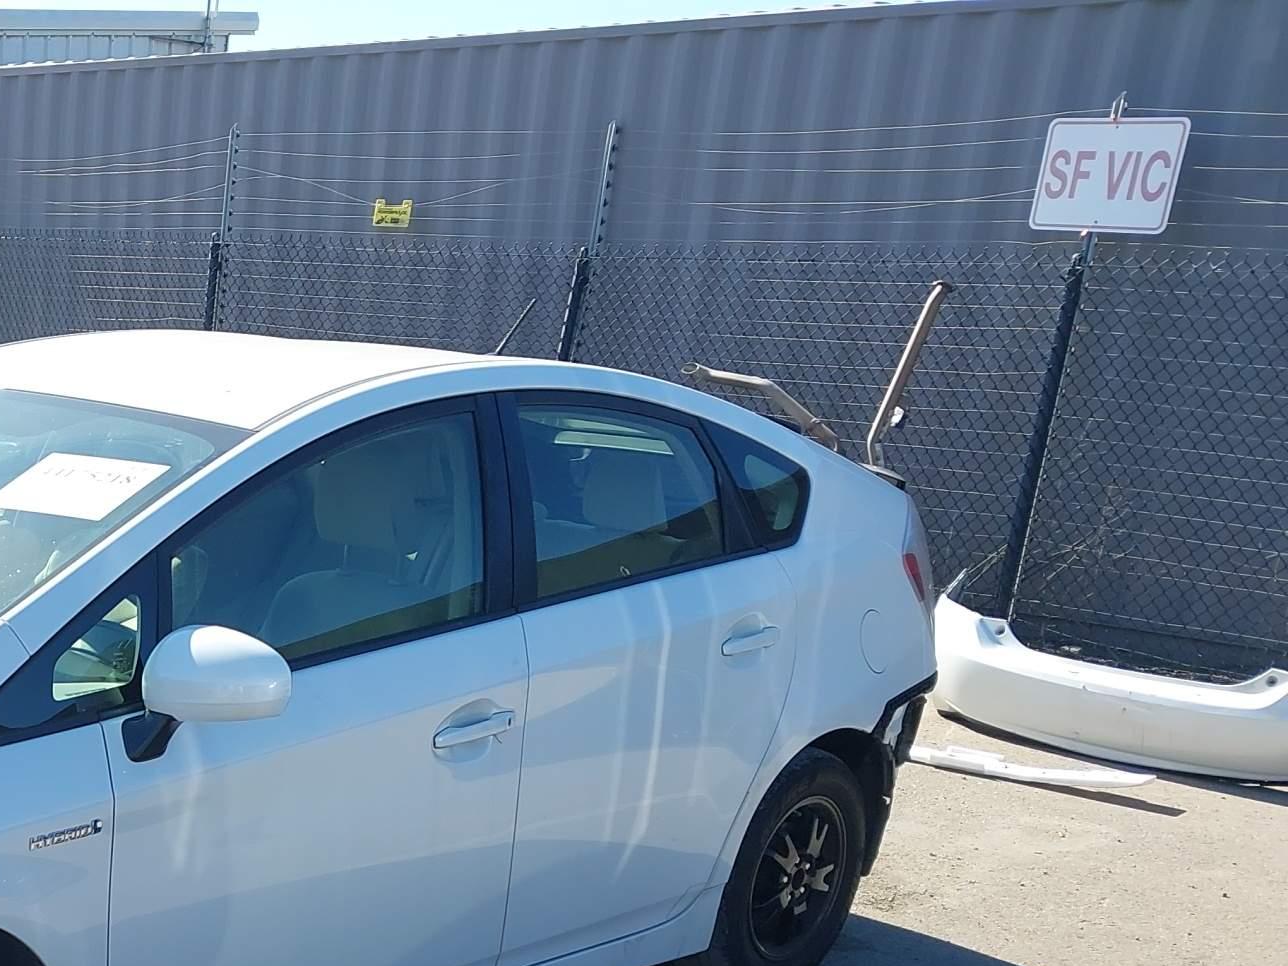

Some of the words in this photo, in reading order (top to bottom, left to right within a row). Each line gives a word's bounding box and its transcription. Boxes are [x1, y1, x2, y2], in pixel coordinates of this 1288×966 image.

[1044, 149, 1097, 200] SF
[1107, 150, 1172, 202] VIC
[28, 824, 93, 852] HYBRID
